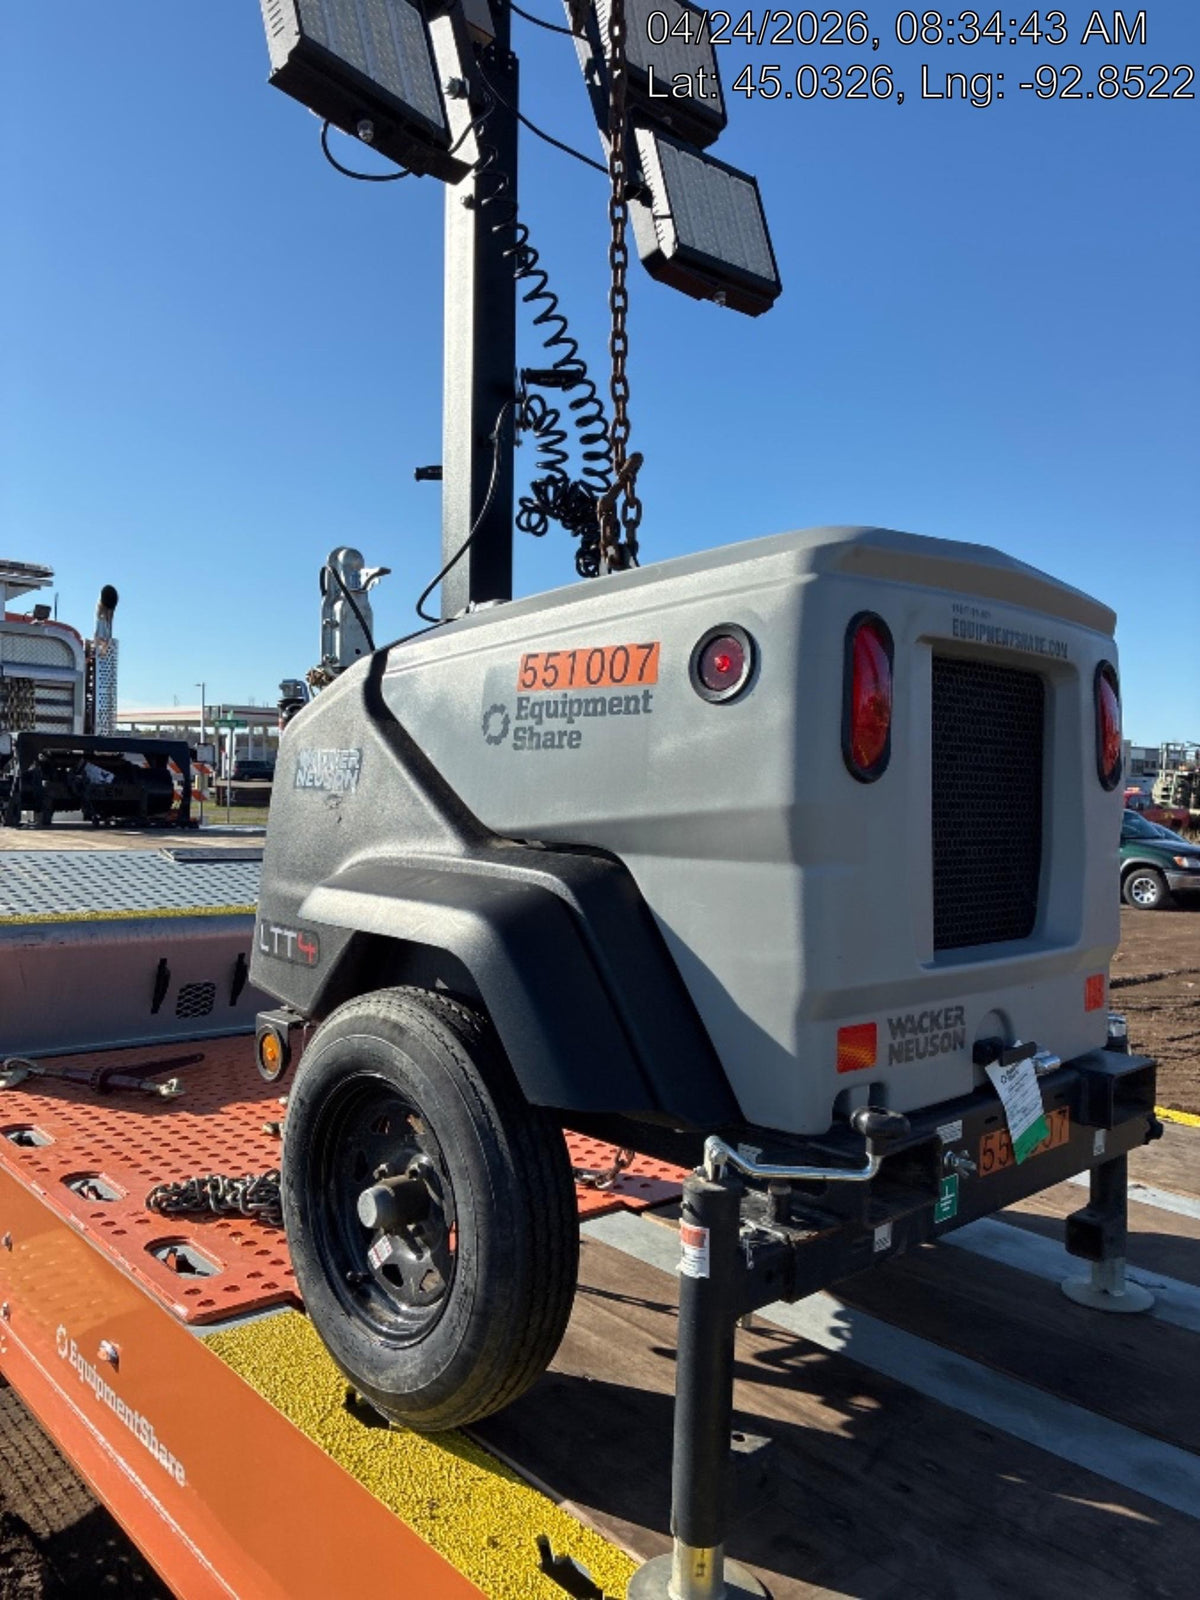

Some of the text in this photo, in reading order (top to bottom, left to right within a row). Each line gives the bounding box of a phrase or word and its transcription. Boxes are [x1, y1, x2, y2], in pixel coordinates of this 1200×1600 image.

[520, 642, 656, 690] 551007
[514, 689, 654, 725] Equipment
[511, 726, 583, 751] Share
[259, 923, 318, 965] LTT4
[887, 1005, 967, 1040] WACKER
[888, 1027, 967, 1067] NEUSON
[68, 1338, 188, 1487] EquipmentShare
